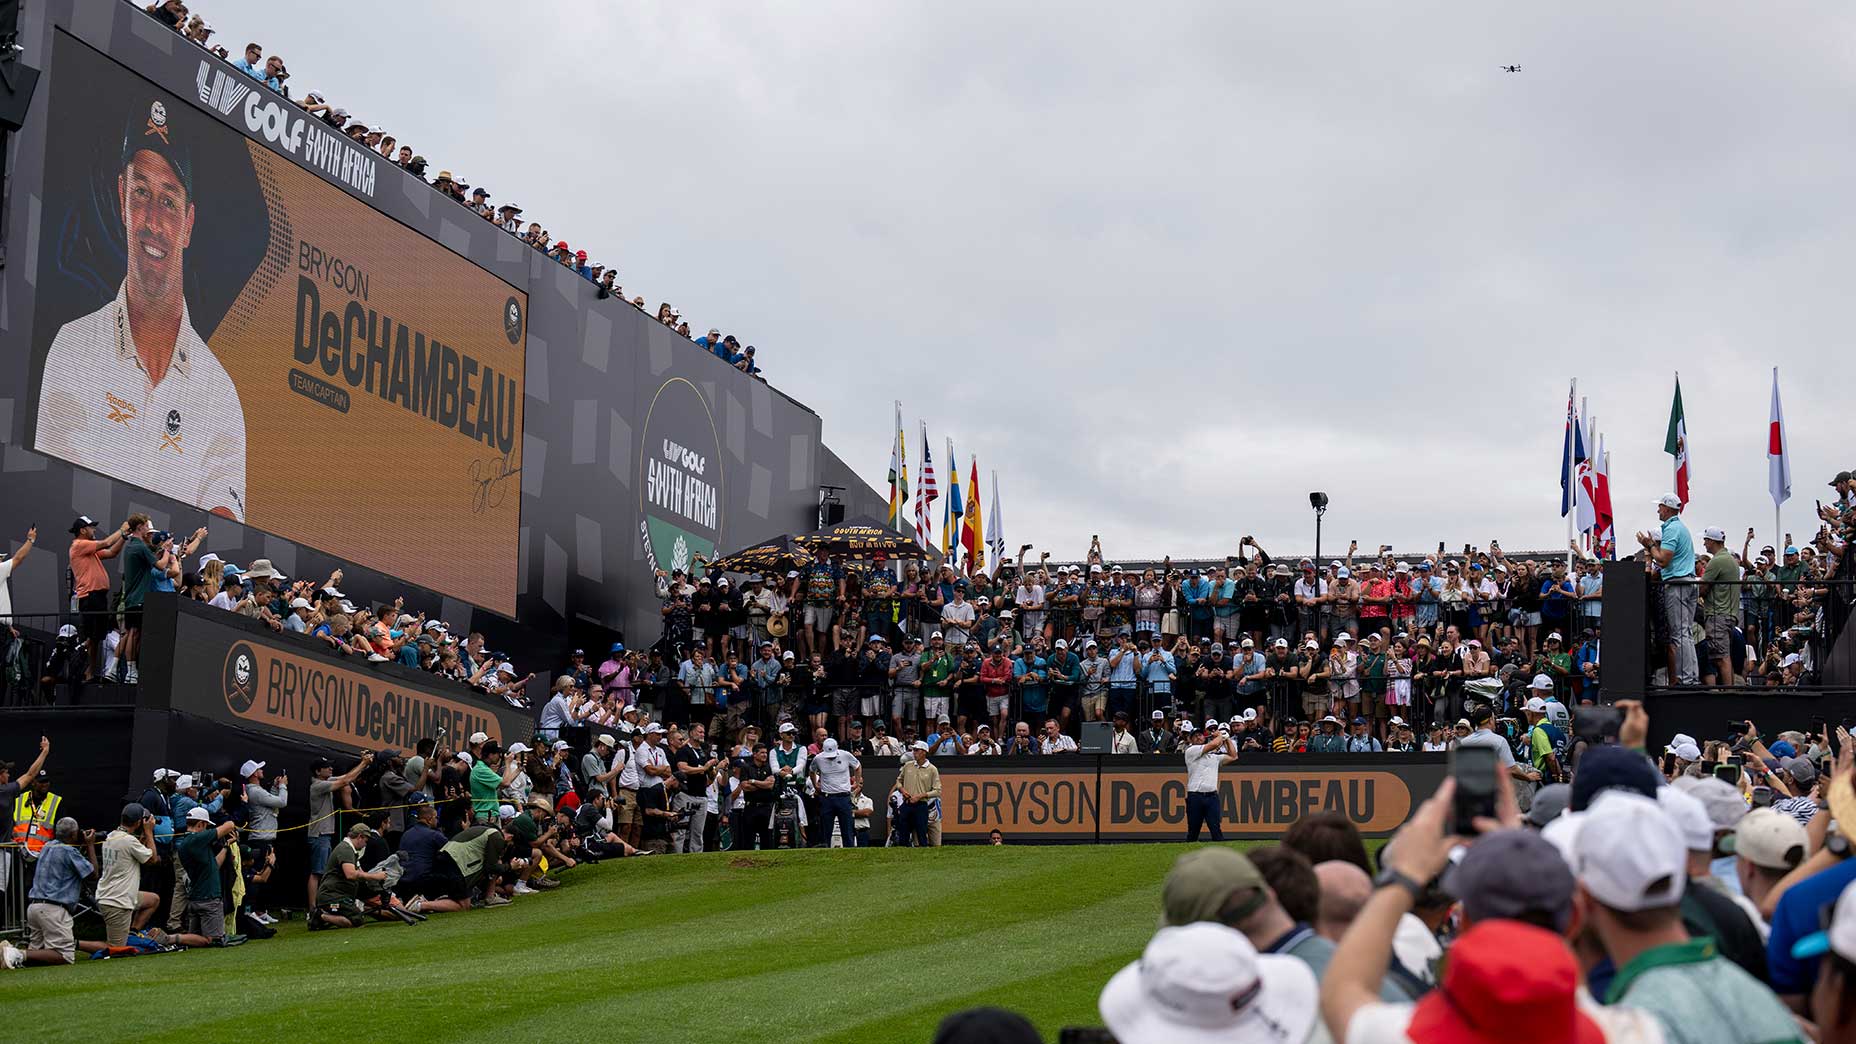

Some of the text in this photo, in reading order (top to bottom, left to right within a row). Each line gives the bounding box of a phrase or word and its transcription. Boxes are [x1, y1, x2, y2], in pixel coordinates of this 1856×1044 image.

[196, 60, 376, 198] LIV GOLF SOUTH AFRICA
[298, 240, 369, 301] BRYSON
[292, 373, 347, 409] TEAM CAPTAIN
[294, 274, 516, 454] DeCHAMBEAU
[681, 447, 705, 475] GOLF
[647, 457, 716, 530] SOUTH AFRICA
[640, 520, 656, 571] STEYN
[267, 658, 353, 733] BRYSON
[957, 779, 1375, 825] BRYSON DeCAMBEAU
